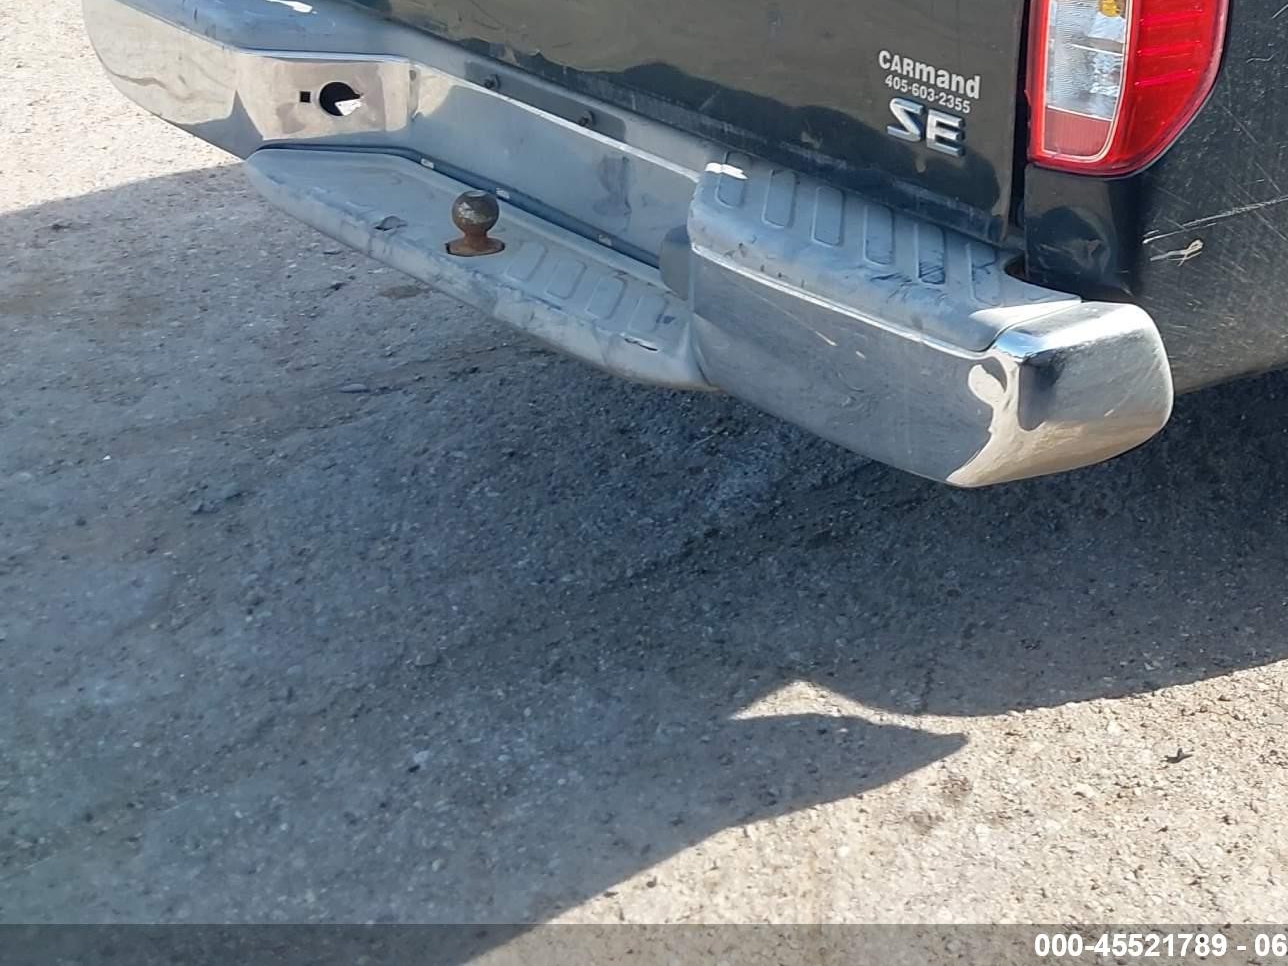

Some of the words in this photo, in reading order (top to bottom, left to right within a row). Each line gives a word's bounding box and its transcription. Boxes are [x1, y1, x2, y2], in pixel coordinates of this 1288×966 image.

[878, 50, 981, 100] CARmand
[884, 74, 971, 114] 405-603-2355
[887, 97, 965, 157] SE
